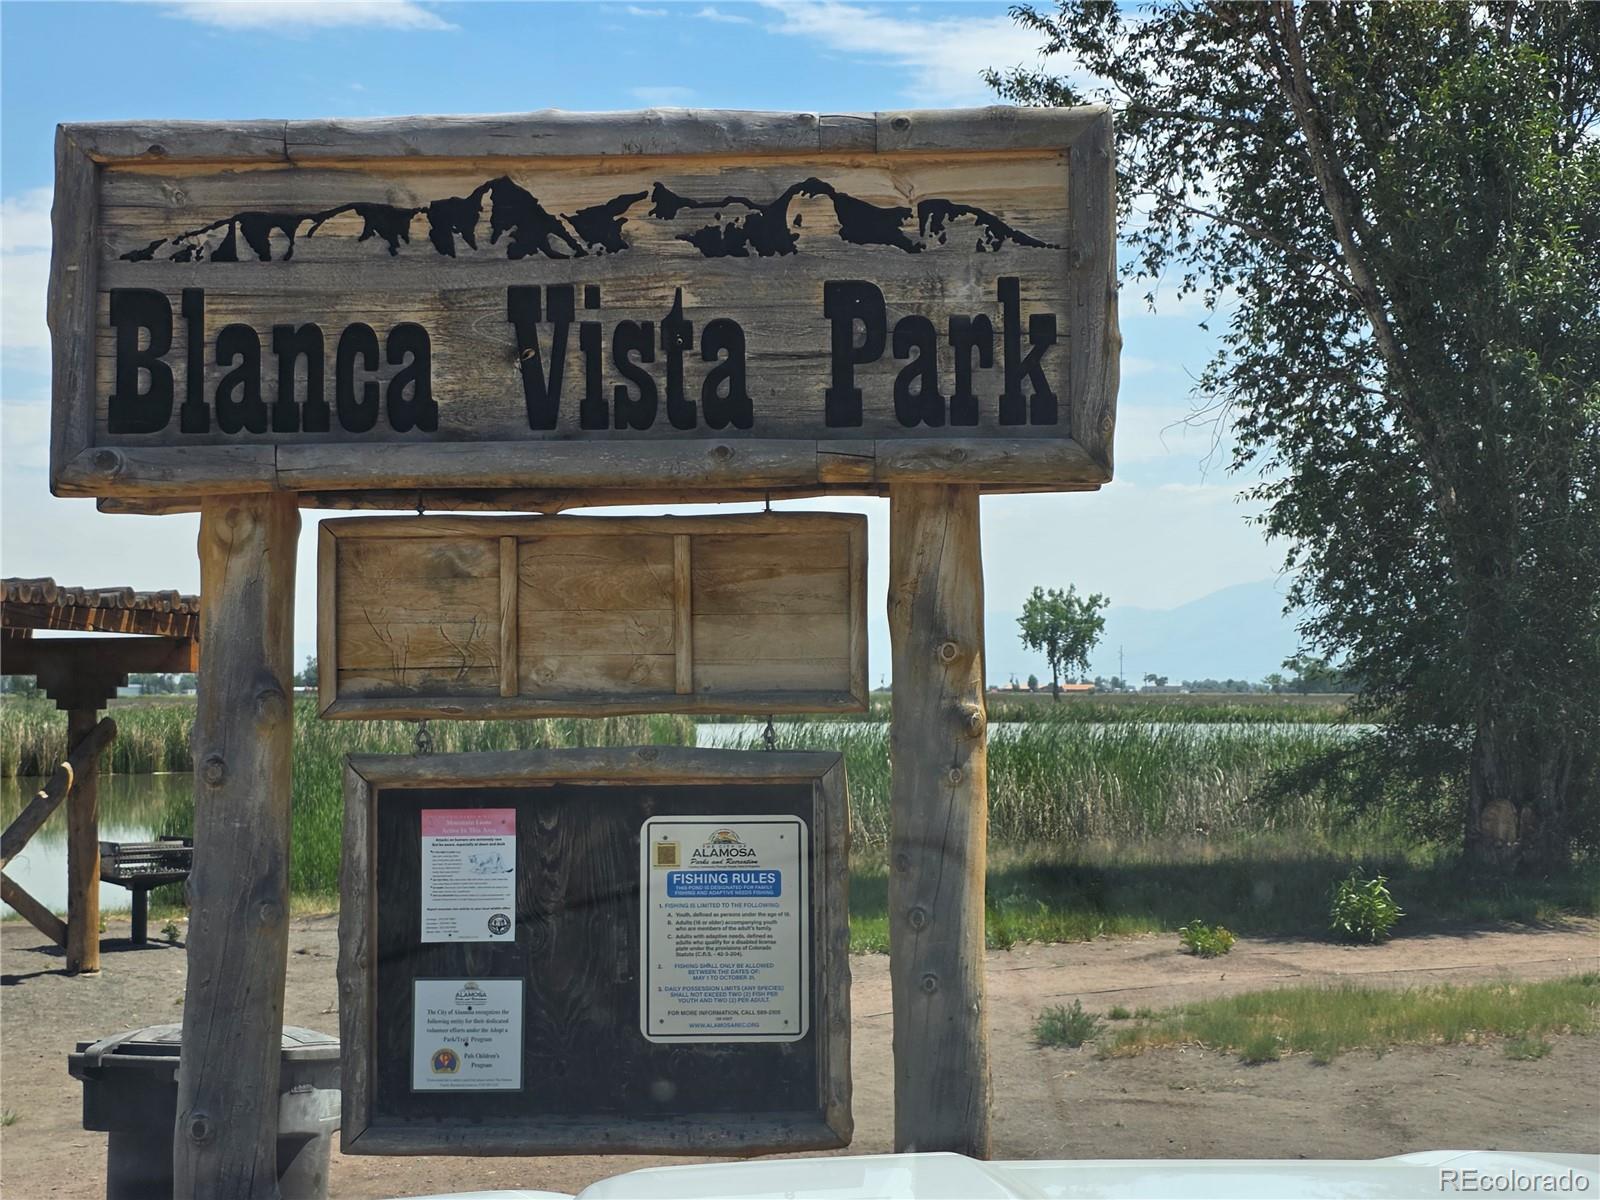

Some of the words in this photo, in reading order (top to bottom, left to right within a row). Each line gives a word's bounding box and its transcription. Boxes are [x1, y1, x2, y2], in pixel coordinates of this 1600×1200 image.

[109, 286, 438, 434] Blanca
[508, 285, 753, 430] Vista
[824, 276, 1058, 425] Park
[693, 848, 756, 857] ALAMOSA
[673, 873, 728, 884] FISHING
[732, 873, 776, 884] RULES
